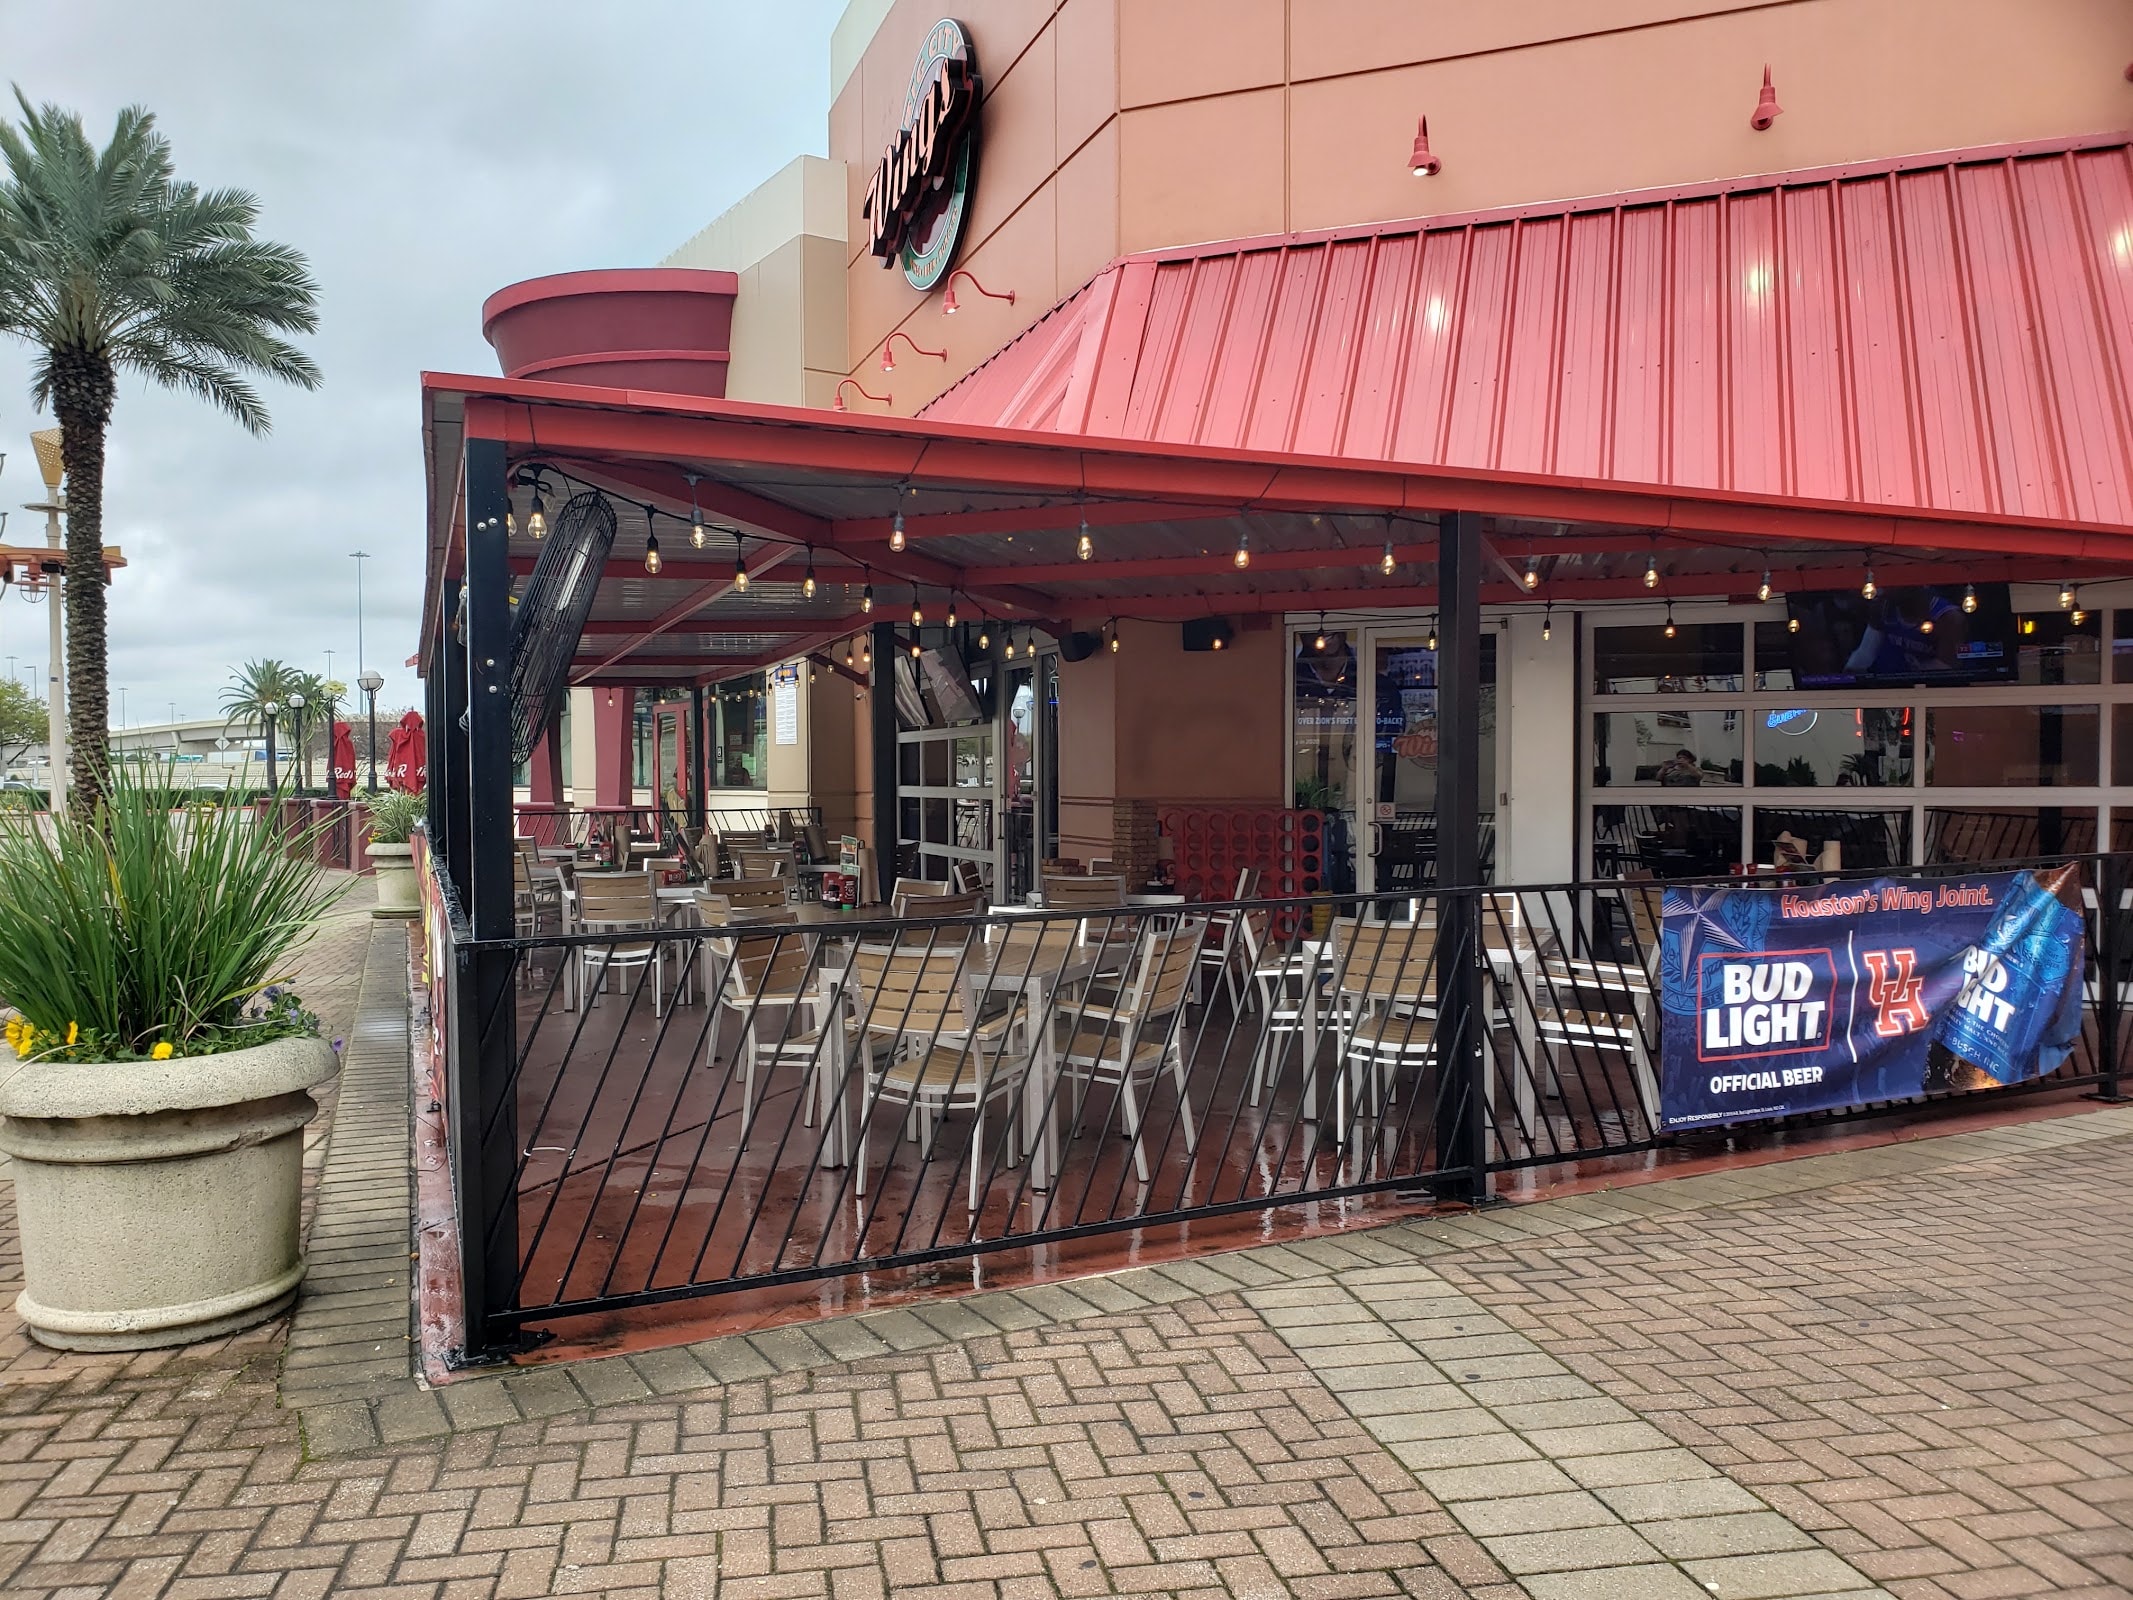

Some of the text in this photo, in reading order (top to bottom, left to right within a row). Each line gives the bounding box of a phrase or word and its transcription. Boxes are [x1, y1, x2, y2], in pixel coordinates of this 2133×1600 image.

[927, 25, 961, 59] CITY
[863, 57, 956, 256] Wings
[1336, 716, 1354, 725] FIRST
[1781, 883, 1994, 919] Houston's Wing Joint.
[1723, 961, 1814, 1005] BUD
[1705, 1000, 1826, 1049] LIGHT
[1710, 1066, 1823, 1094] OFFICIAL BEER
